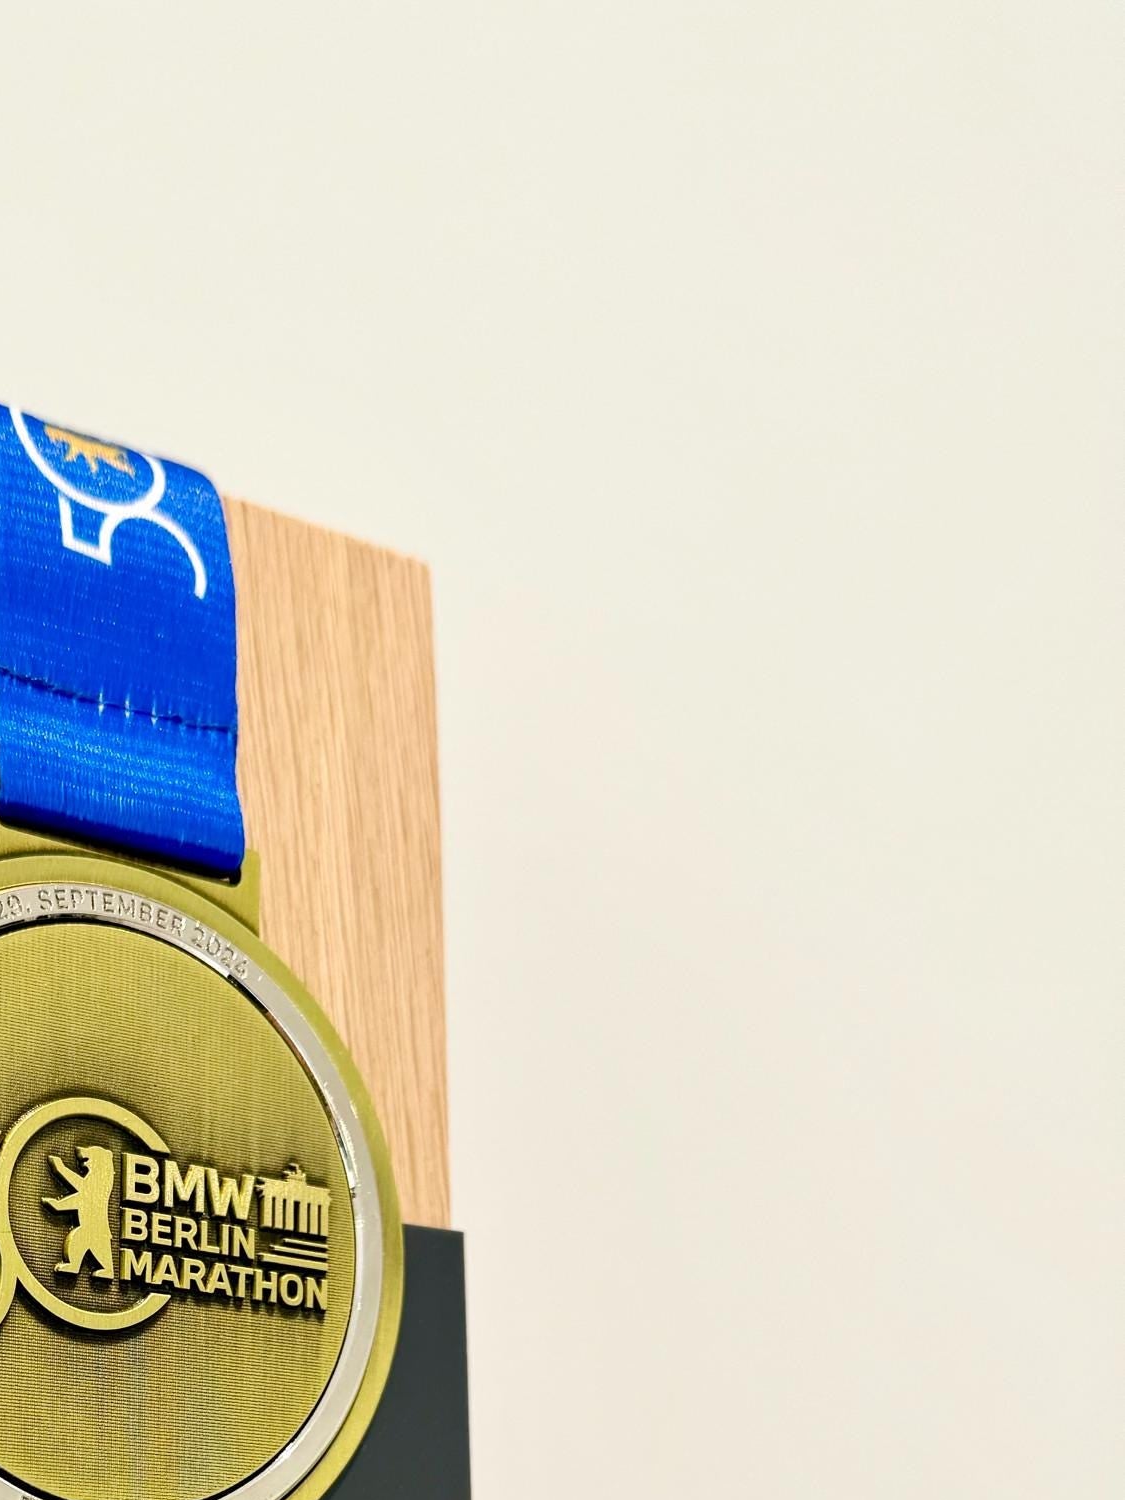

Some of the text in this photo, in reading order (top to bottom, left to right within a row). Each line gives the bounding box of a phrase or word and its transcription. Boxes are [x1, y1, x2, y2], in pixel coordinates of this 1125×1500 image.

[37, 889, 186, 937] SEPTEMBER
[192, 921, 249, 981] 2024
[121, 1152, 255, 1221] BMW
[121, 1206, 257, 1260] BERLIN
[119, 1247, 328, 1312] MARATHON
